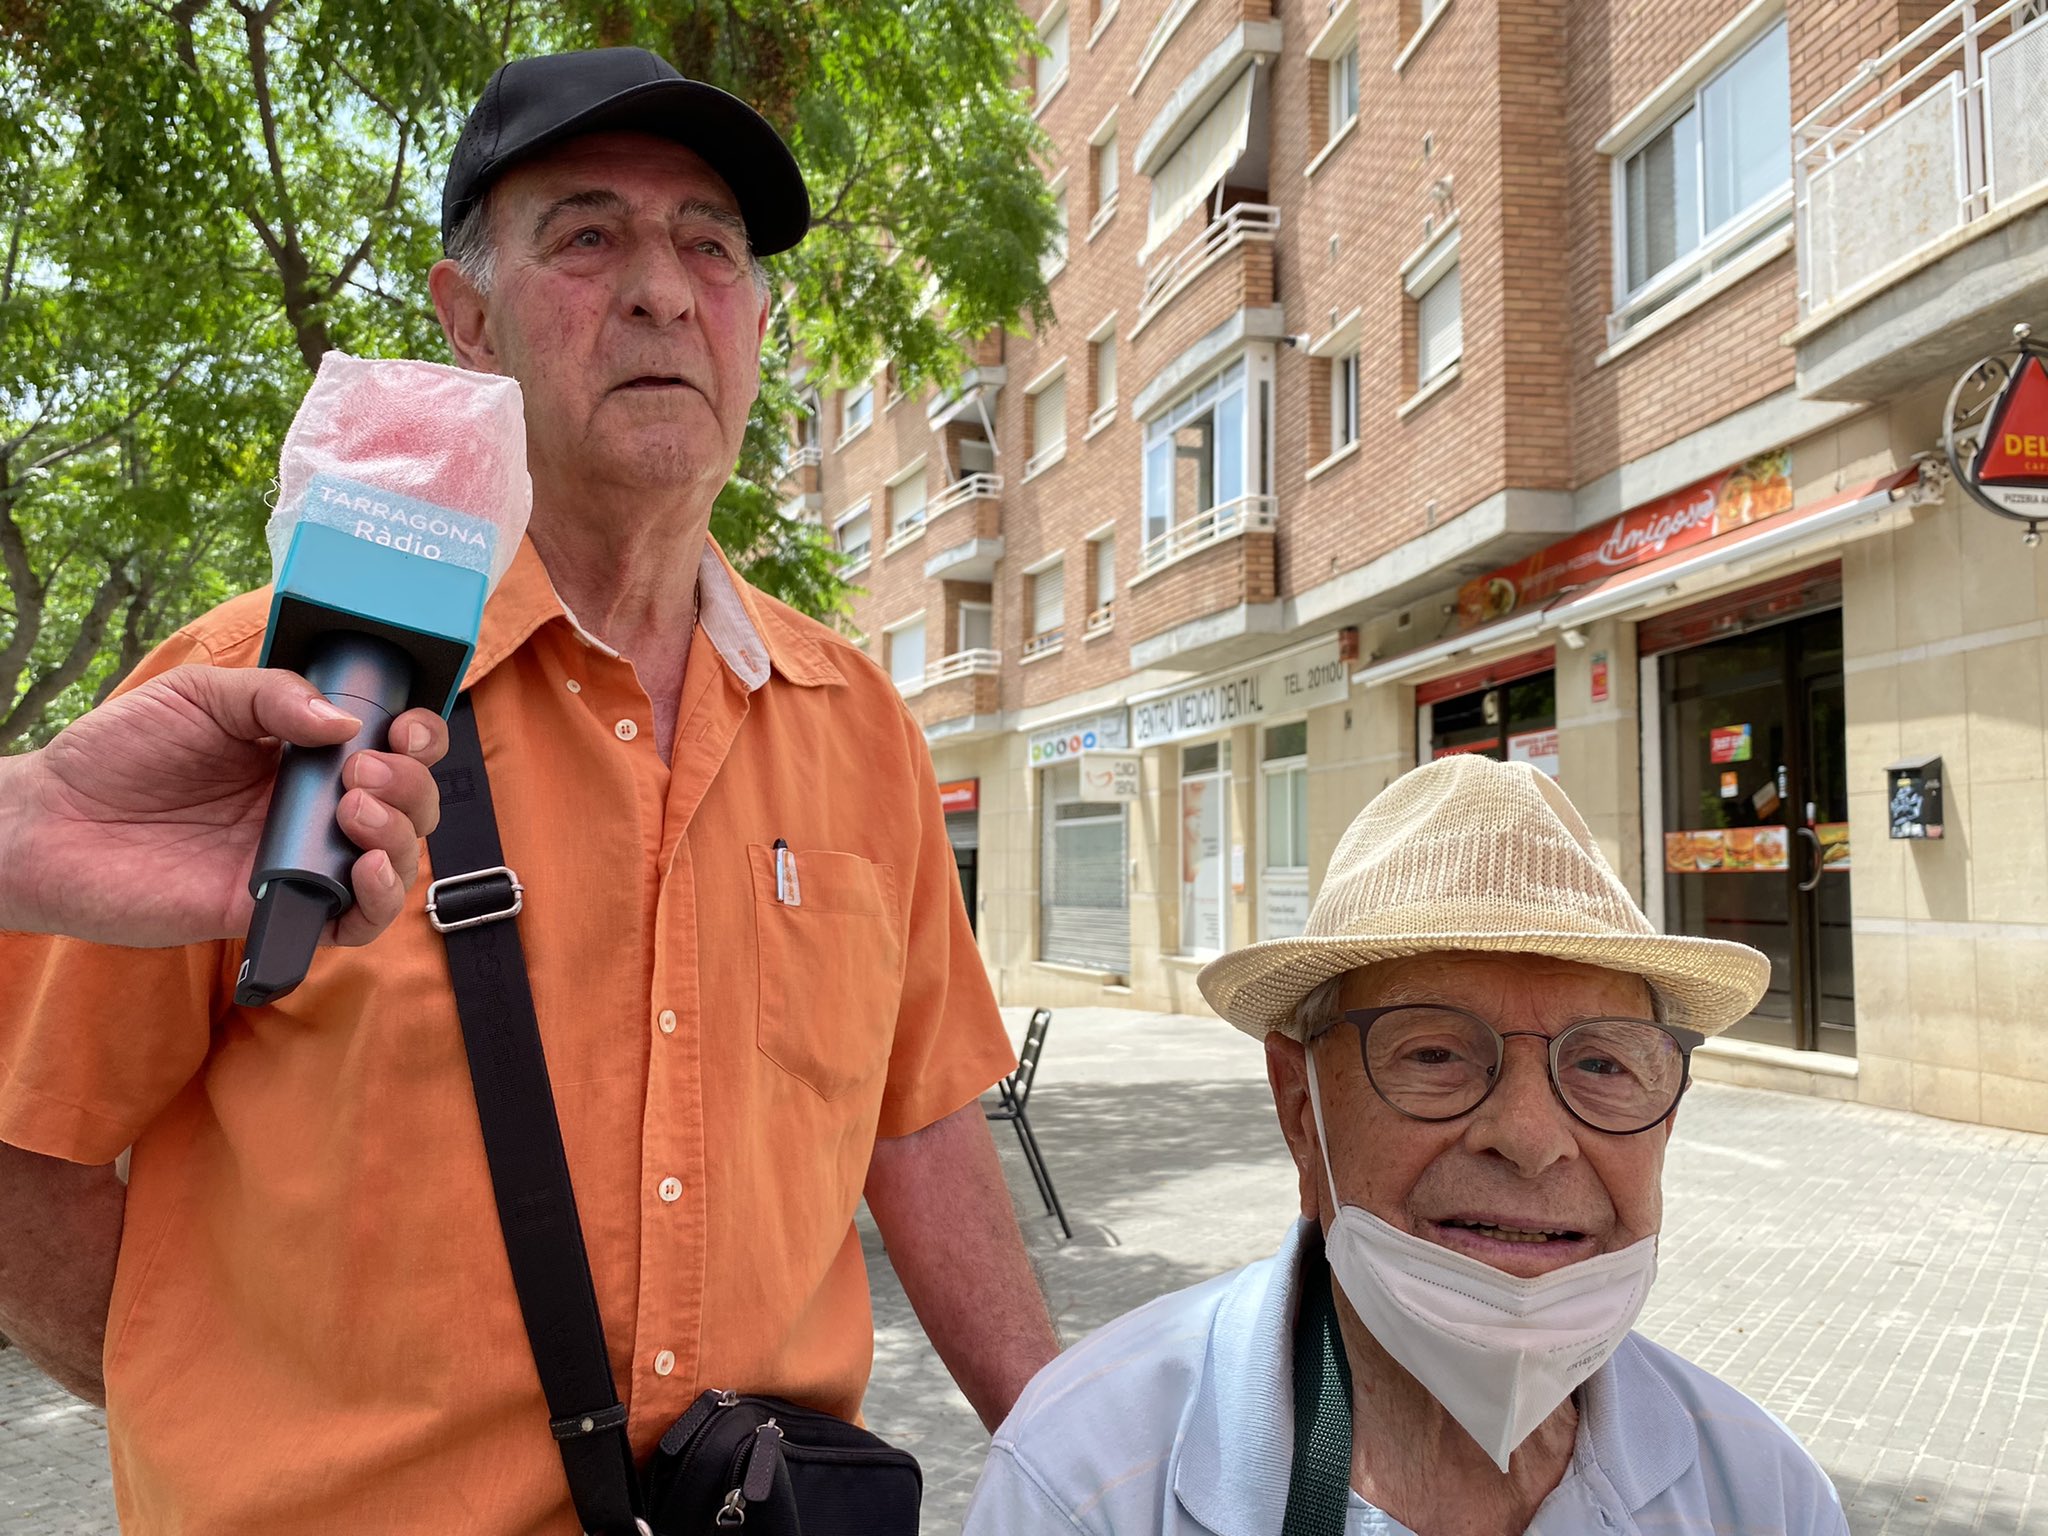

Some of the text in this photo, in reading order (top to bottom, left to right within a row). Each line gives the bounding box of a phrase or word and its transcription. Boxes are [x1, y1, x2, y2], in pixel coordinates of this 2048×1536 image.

[2004, 434, 2048, 458] DEL
[320, 486, 487, 549] TARRAGONA
[354, 519, 442, 560] Ràdio
[1599, 500, 1699, 566] Amigos
[1137, 702, 1174, 740] CENTRO
[1177, 686, 1216, 730] MEDICO
[1220, 674, 1264, 720] DENTAL
[1283, 674, 1304, 697] TEL.
